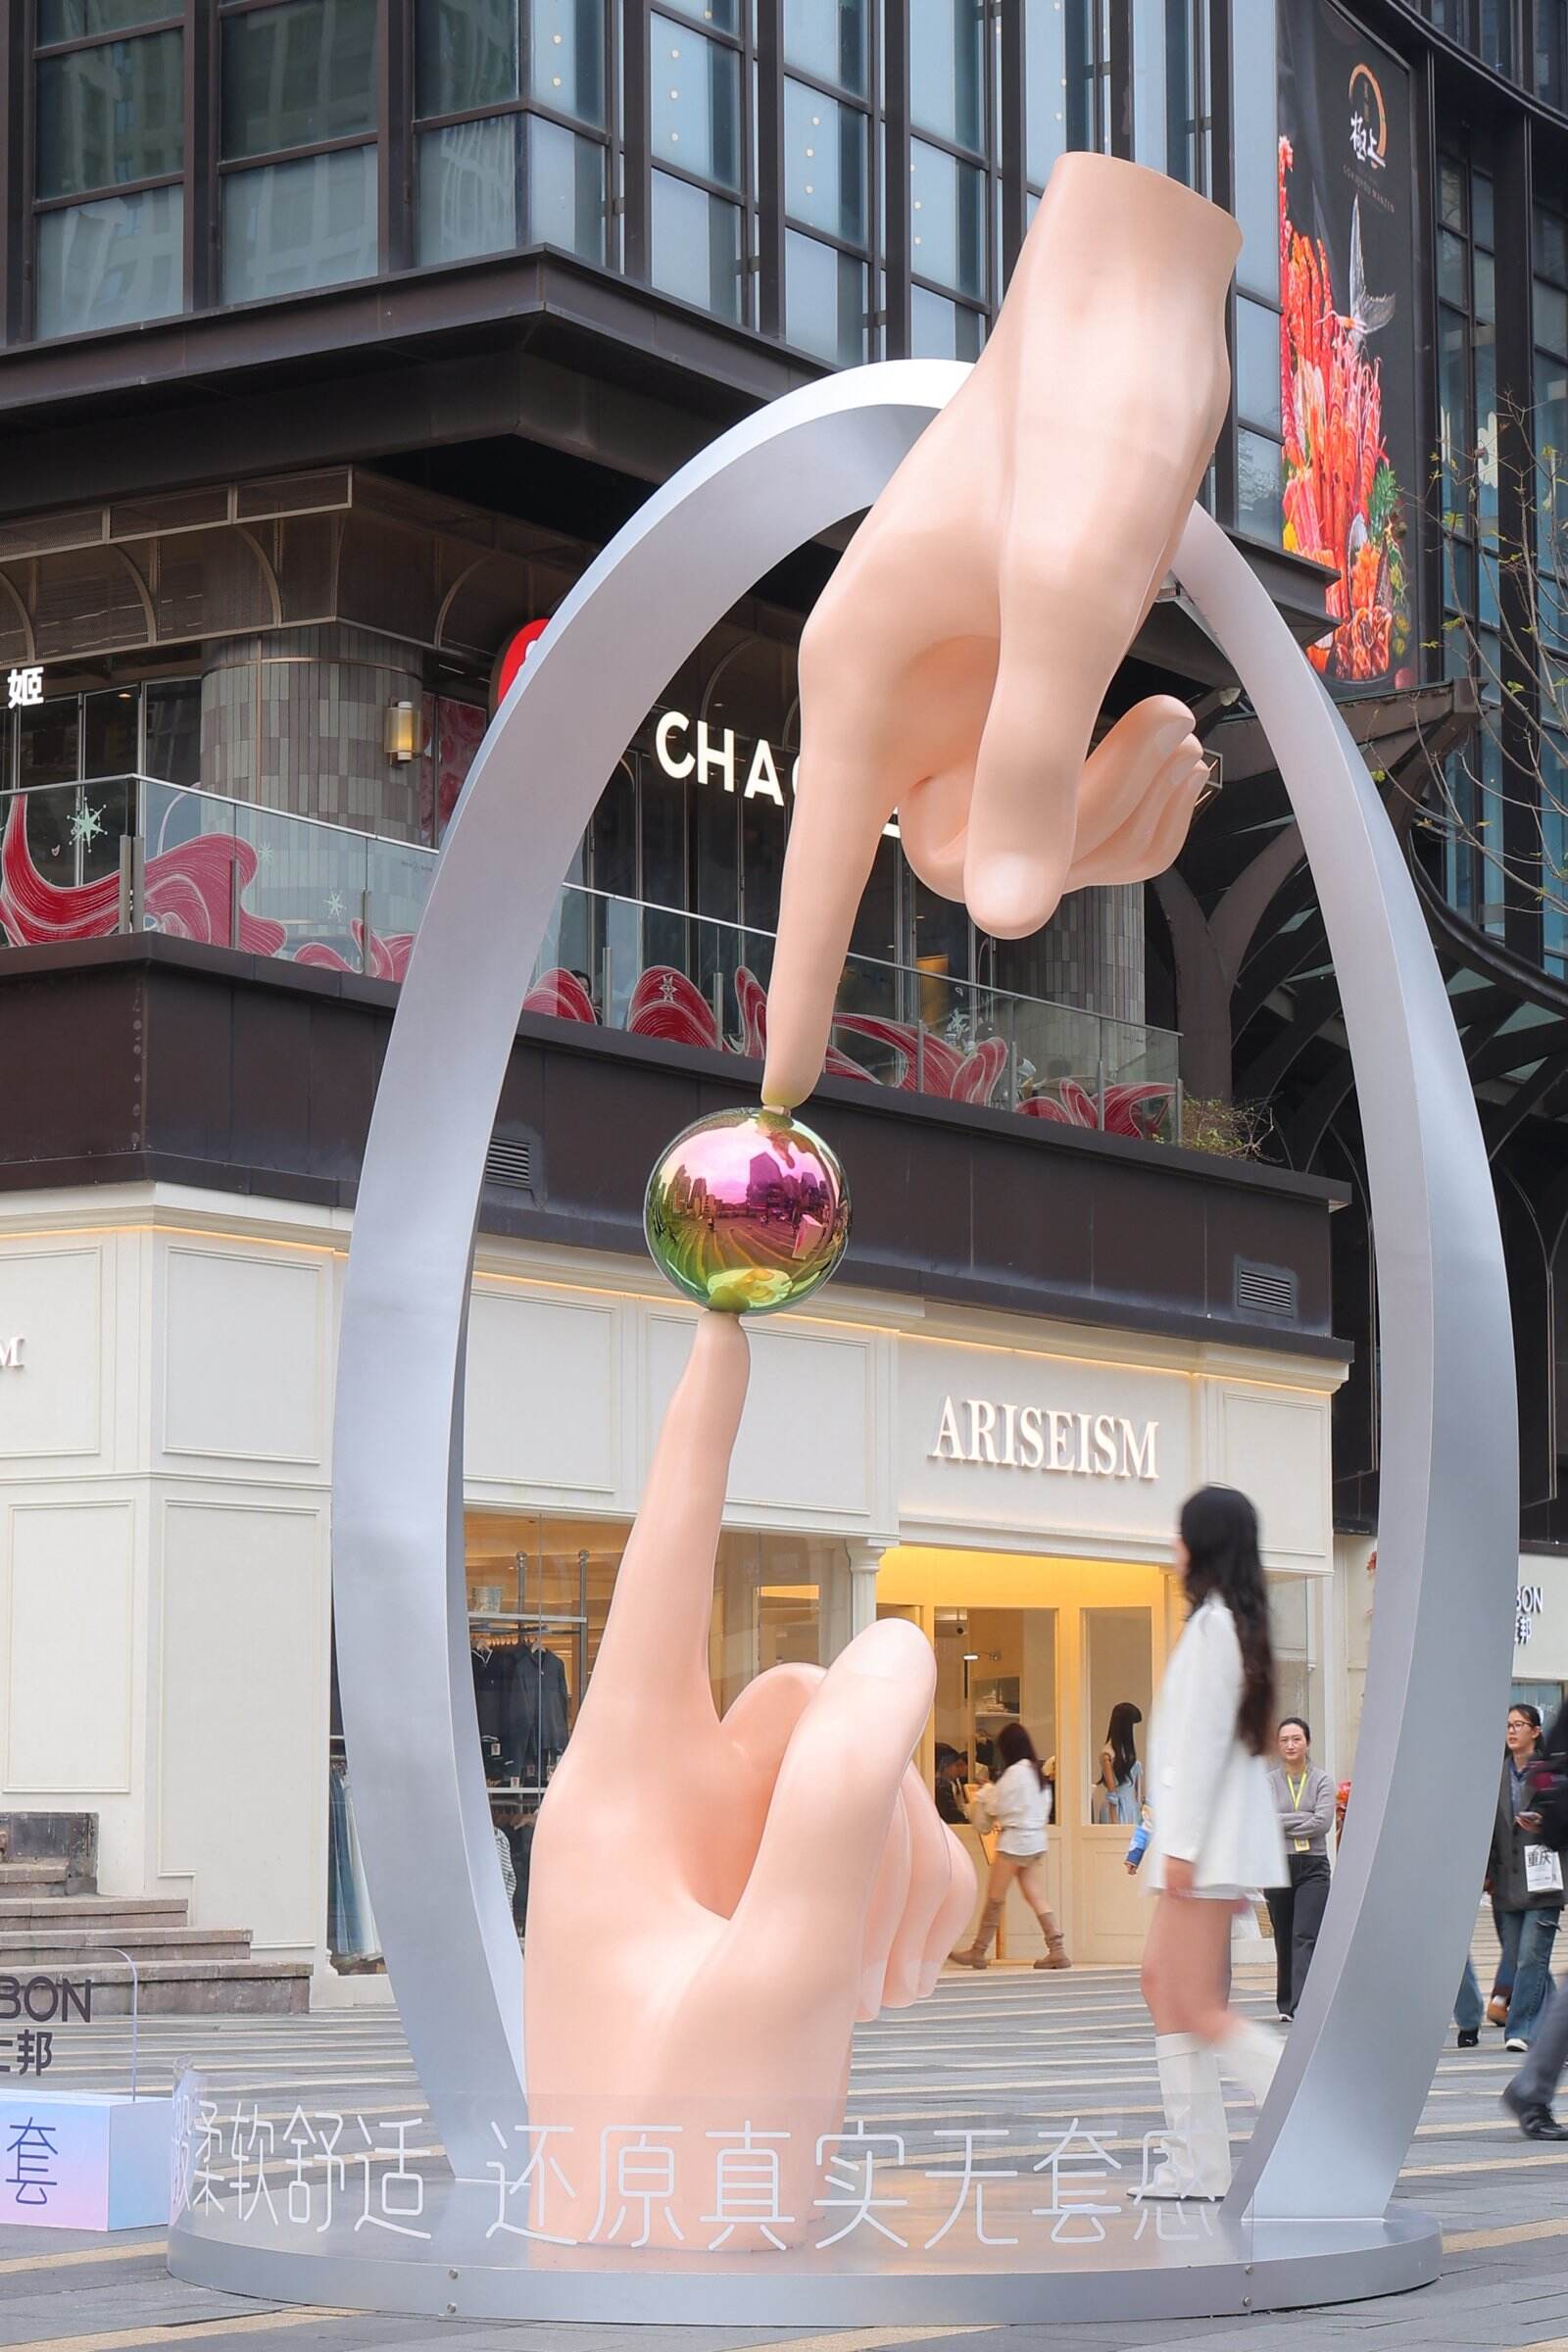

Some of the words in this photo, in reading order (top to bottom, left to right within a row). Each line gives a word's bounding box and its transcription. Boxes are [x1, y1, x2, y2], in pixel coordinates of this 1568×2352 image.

[7, 665, 45, 710] 姬
[931, 1395, 1160, 1480] ARISEISM
[5, 2116, 59, 2205] 套
